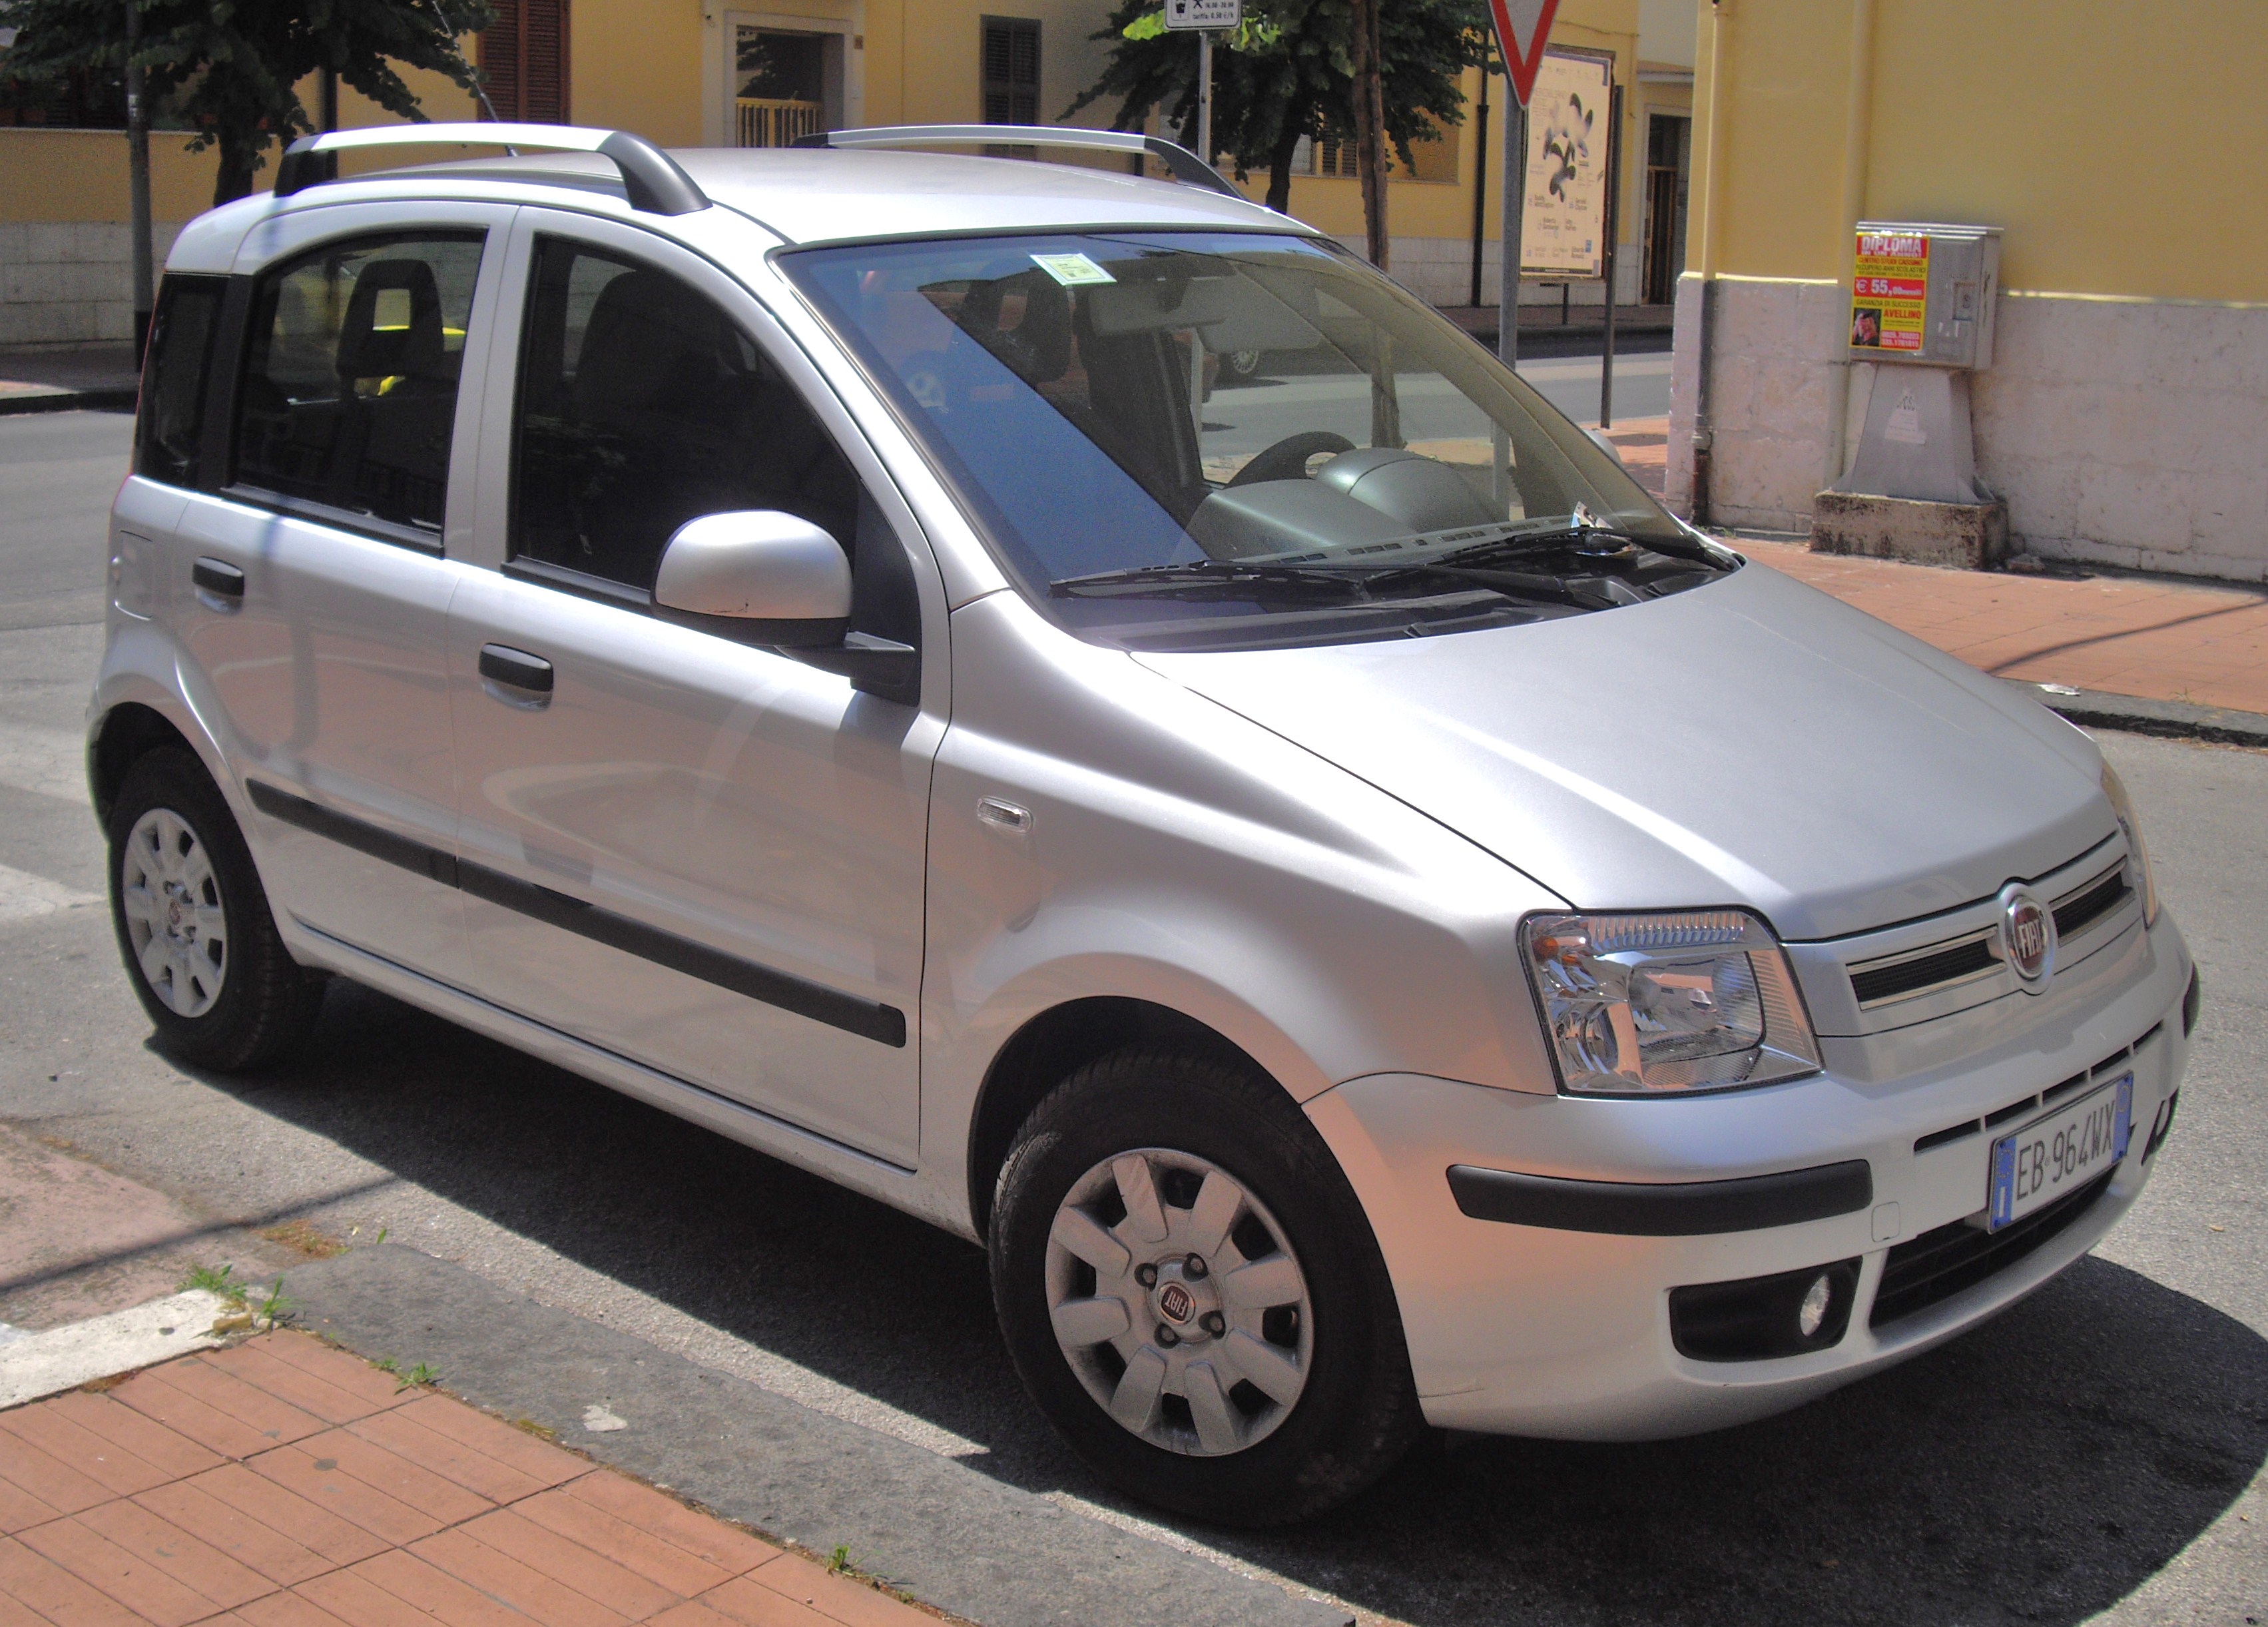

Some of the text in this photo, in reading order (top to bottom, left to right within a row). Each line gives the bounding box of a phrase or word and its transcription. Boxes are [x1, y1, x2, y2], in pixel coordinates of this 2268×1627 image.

[1861, 236, 1922, 252] DIPLOMA
[1856, 279, 1868, 293] €
[1883, 309, 1922, 319] AVELLINO
[2018, 920, 2042, 958] FIAT
[1165, 1291, 1188, 1317] FIAT
